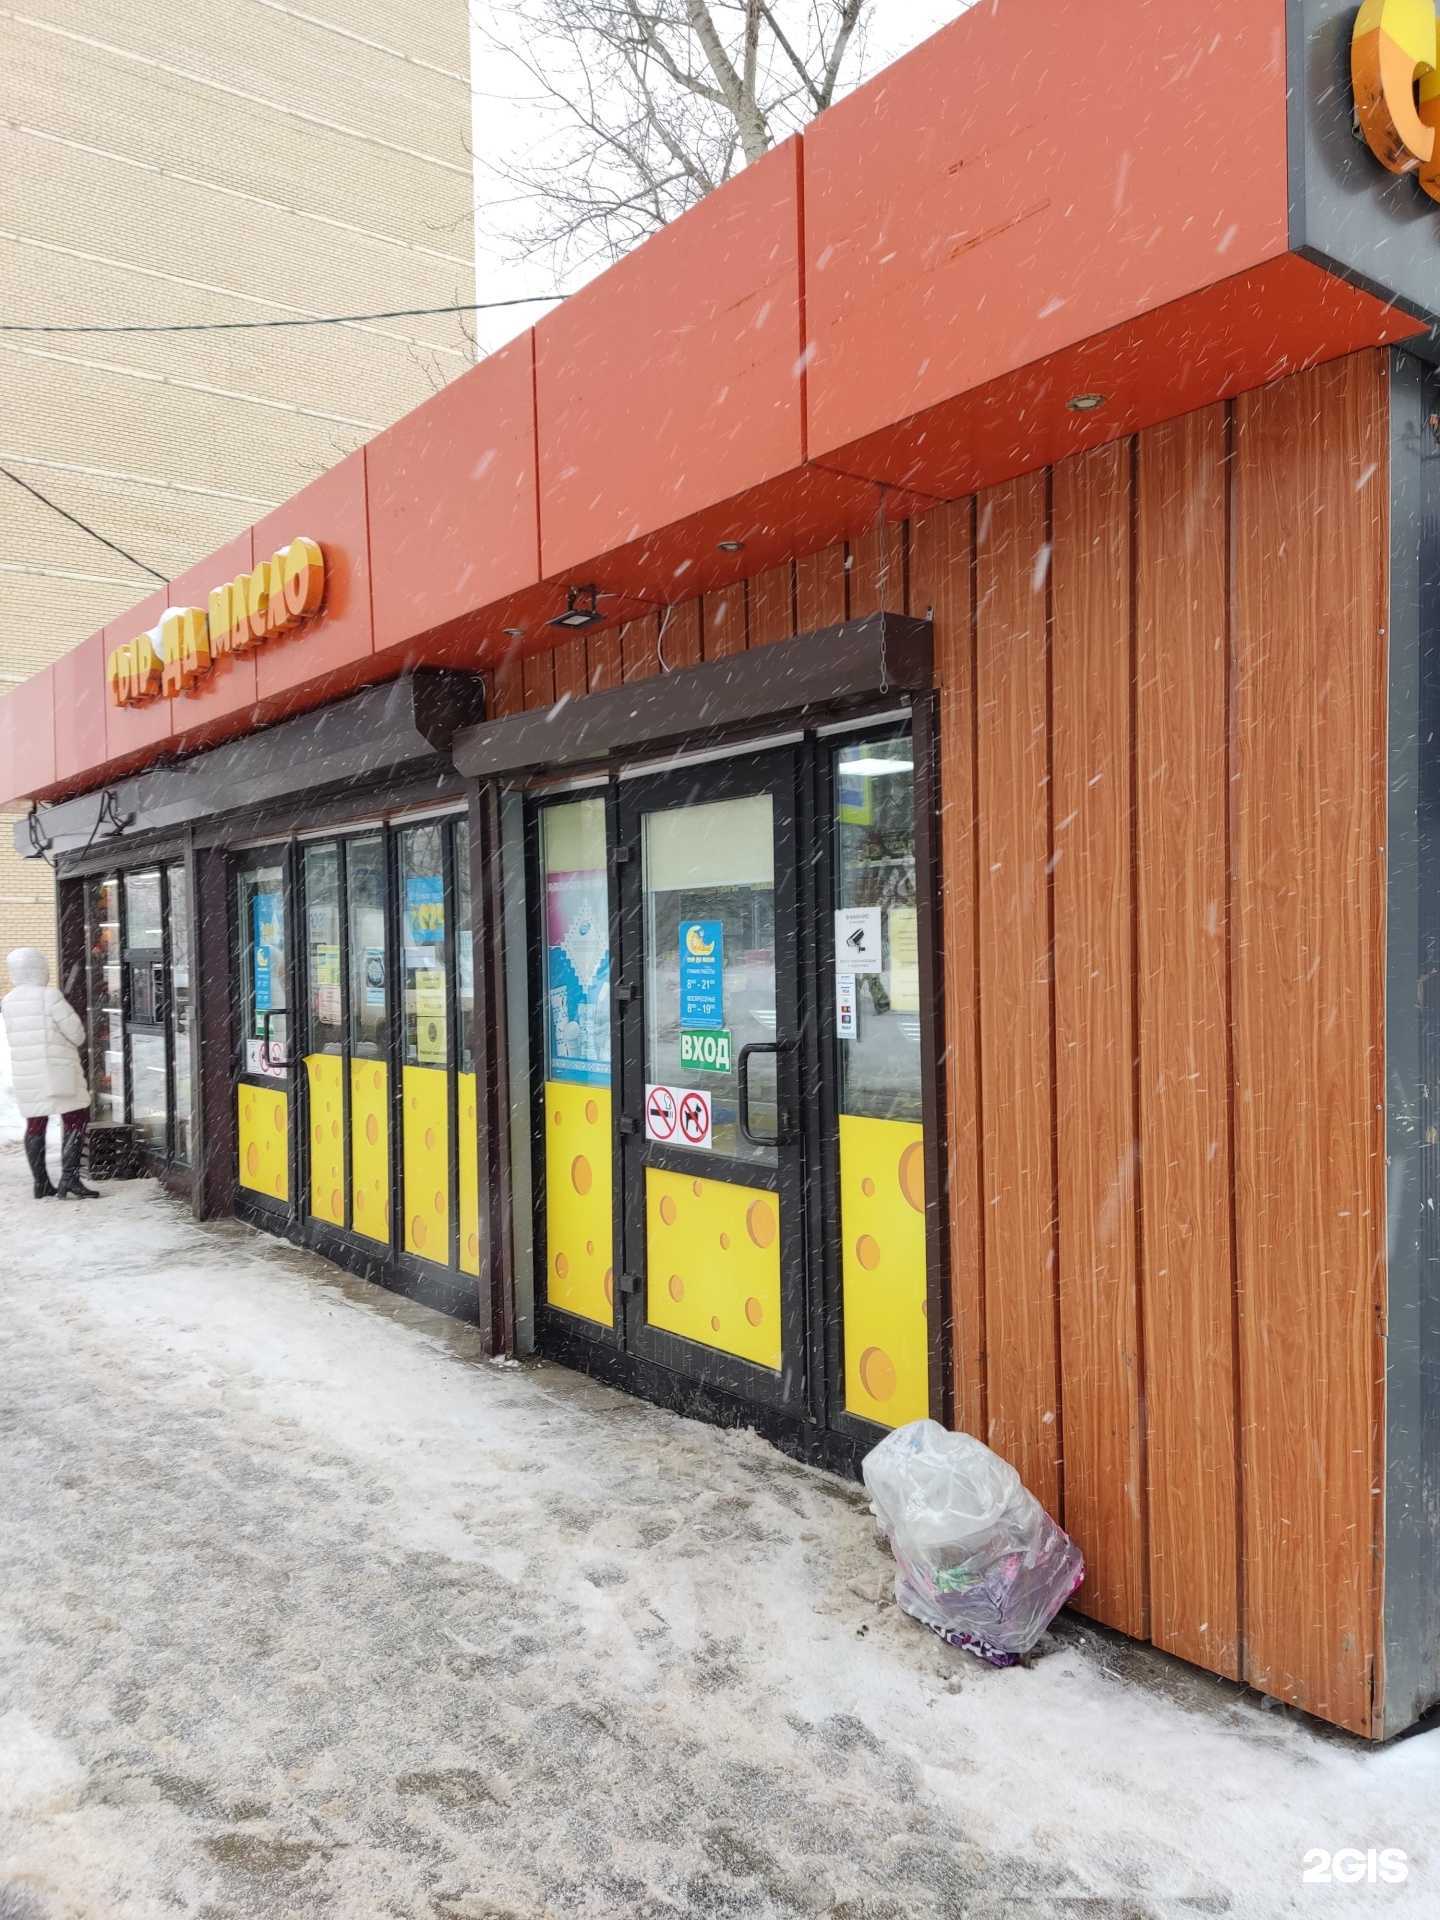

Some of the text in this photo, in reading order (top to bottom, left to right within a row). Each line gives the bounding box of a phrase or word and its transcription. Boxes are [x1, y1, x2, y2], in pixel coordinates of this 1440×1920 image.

[108, 633, 163, 707] СЫР
[208, 537, 324, 660] МАСЛО
[681, 1035, 730, 1070] ВХОД
